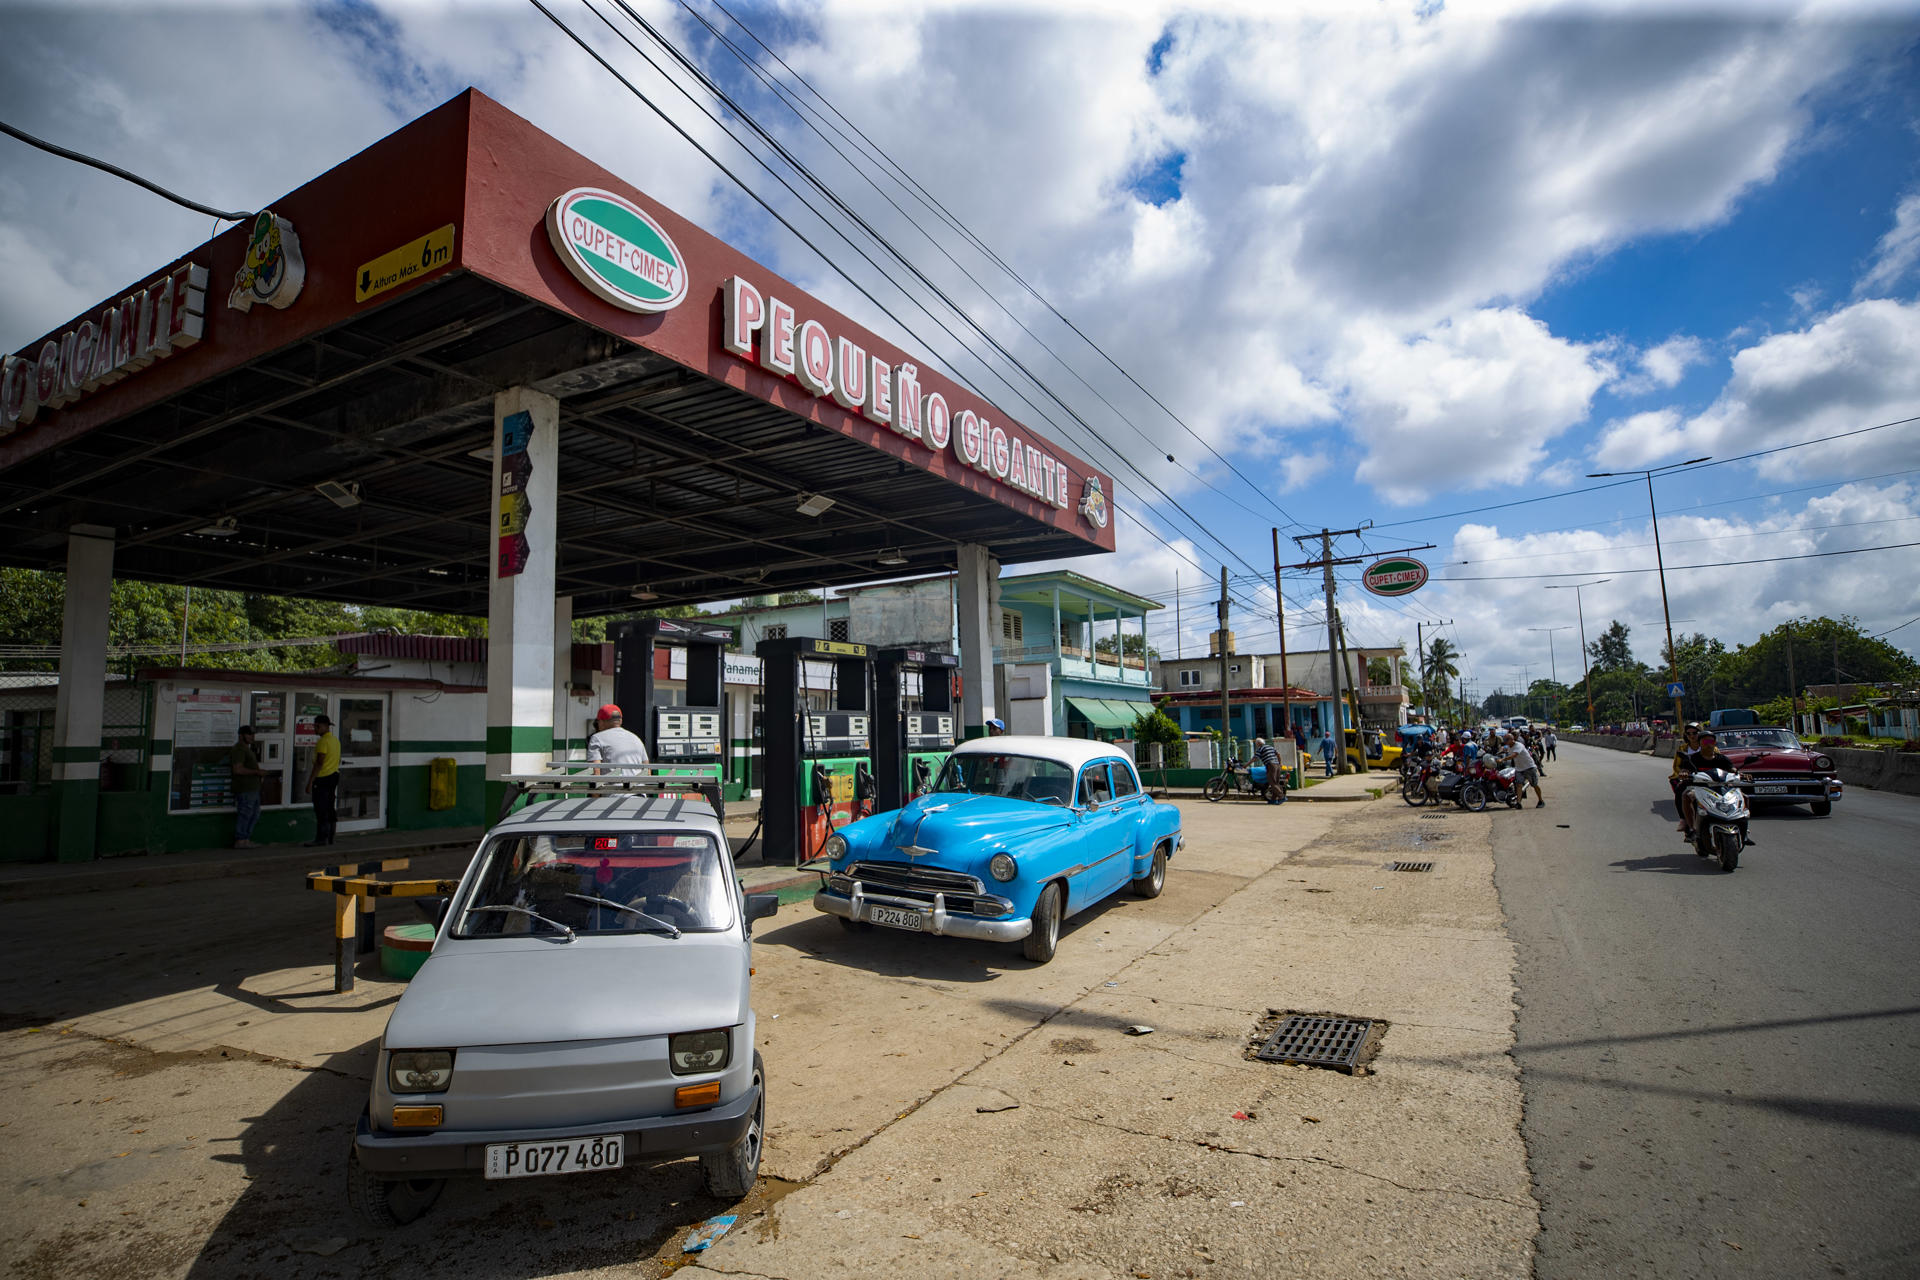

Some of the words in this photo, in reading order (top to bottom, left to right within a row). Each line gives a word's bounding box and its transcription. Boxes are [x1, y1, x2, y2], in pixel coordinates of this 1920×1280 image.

[572, 217, 676, 291] CUPET-CIMEX
[373, 273, 397, 290] Altura
[399, 263, 420, 280] Máx.
[36, 262, 202, 407] GIGANTE
[726, 274, 951, 451] PEQUEÑO
[953, 408, 1069, 510] GIGANTE
[1369, 570, 1422, 586] CUPET-CIMEX
[847, 778, 853, 790] 5
[596, 839, 608, 848] 20
[902, 914, 919, 928] 808
[575, 1140, 620, 1169] 480
